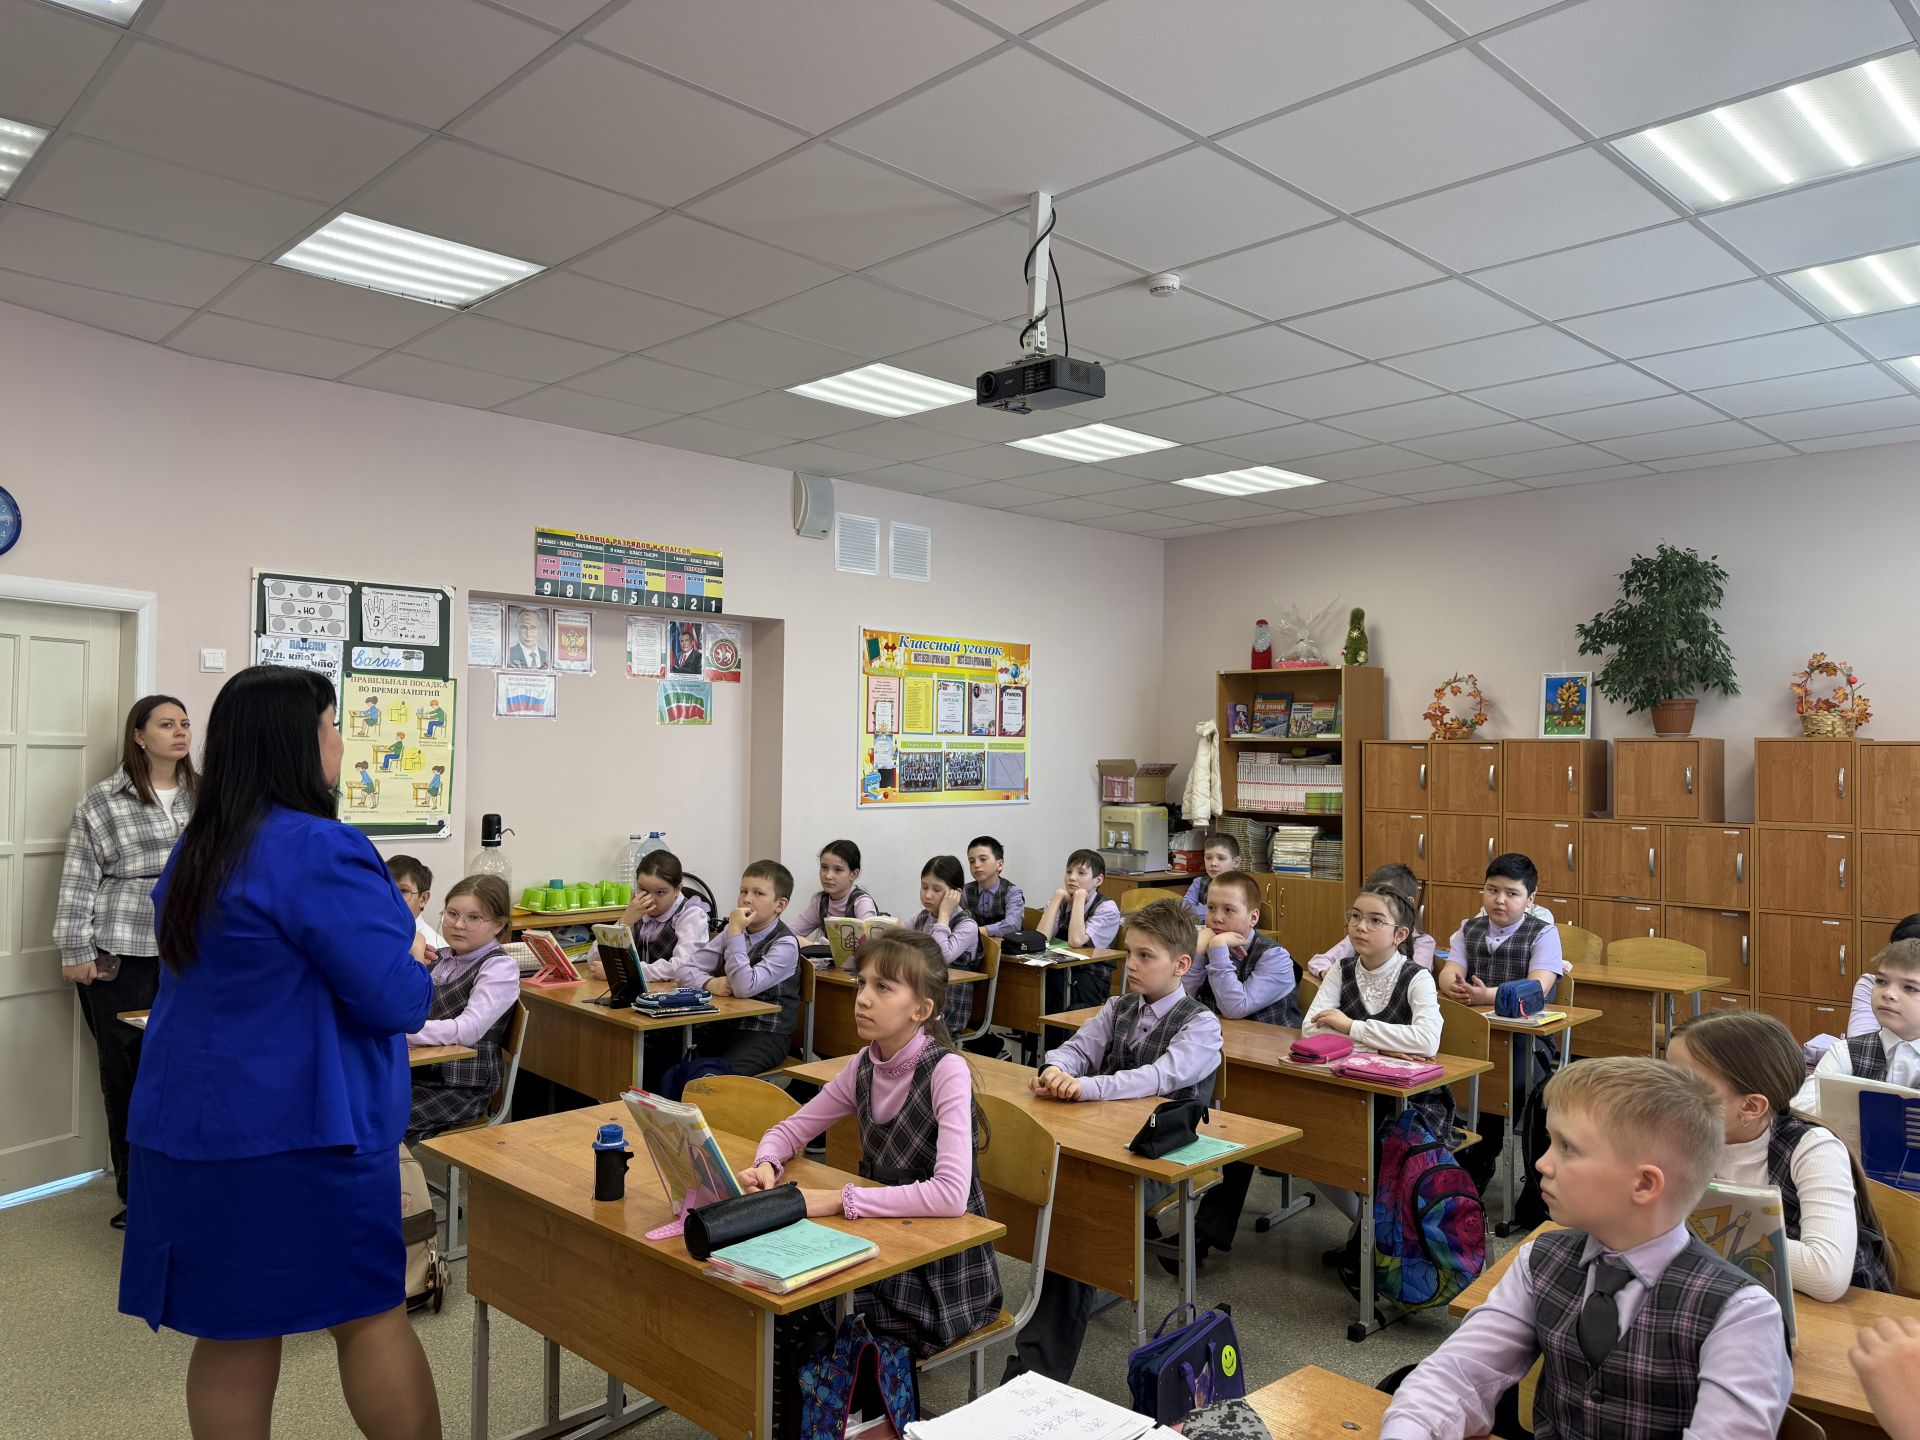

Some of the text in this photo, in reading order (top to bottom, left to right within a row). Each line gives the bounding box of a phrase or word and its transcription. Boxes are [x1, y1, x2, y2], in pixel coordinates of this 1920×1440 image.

[575, 534, 610, 544] ТАБЛИЦА
[613, 538, 650, 549] РАЗРЯДОВ
[660, 545, 691, 555] КЛАССОВ
[543, 569, 599, 580] МИЛЛИОНОВ
[621, 578, 648, 586] ТЫСЯЧ
[544, 582, 716, 612] 9 8 7 6 5 4 3 2 1
[373, 616, 380, 628] 5
[898, 635, 1002, 656] Классный уголок
[351, 676, 448, 688] ПРАВИЛЬНАЯ ПОСАДКА
[372, 686, 399, 694] ВРЕМЯ
[401, 688, 440, 696] ЗАНЯТИЙ
